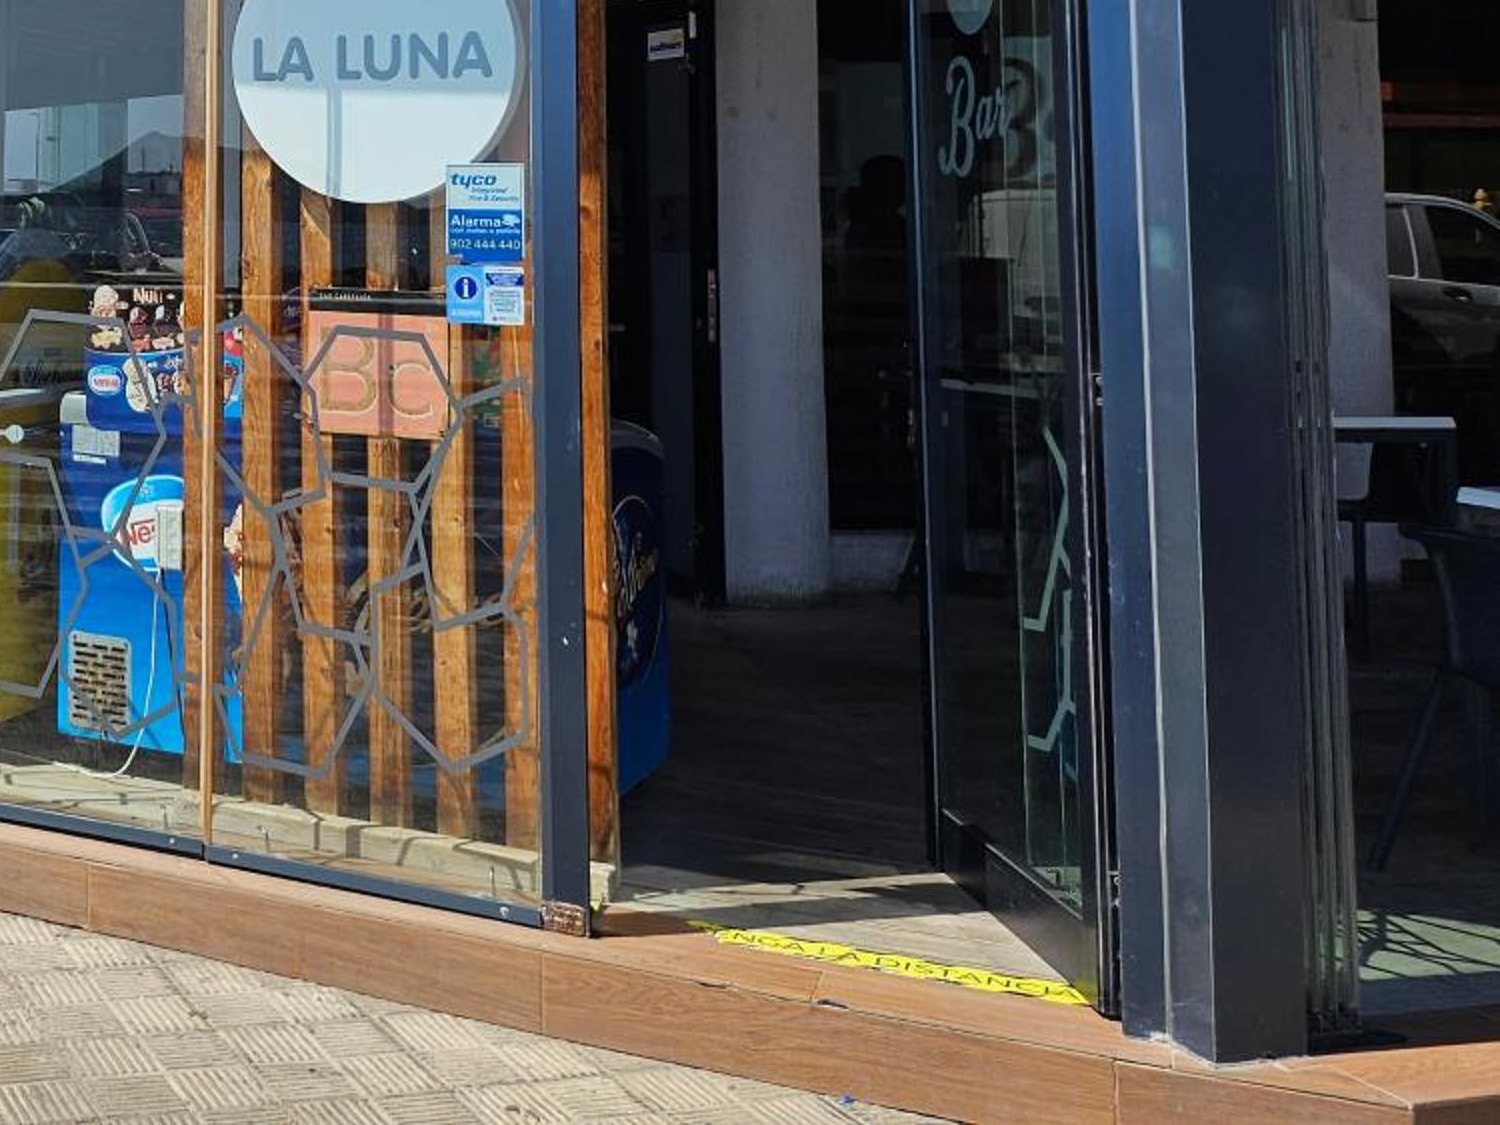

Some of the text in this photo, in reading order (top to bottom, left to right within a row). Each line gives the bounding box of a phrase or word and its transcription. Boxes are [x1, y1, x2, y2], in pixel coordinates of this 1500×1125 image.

[253, 31, 493, 82] LA LUNA
[938, 55, 1010, 177] Bar
[451, 173, 497, 188] tyco
[451, 214, 501, 227] Alarma
[451, 238, 472, 250] 902
[875, 956, 1084, 1005] DISTANCIA
